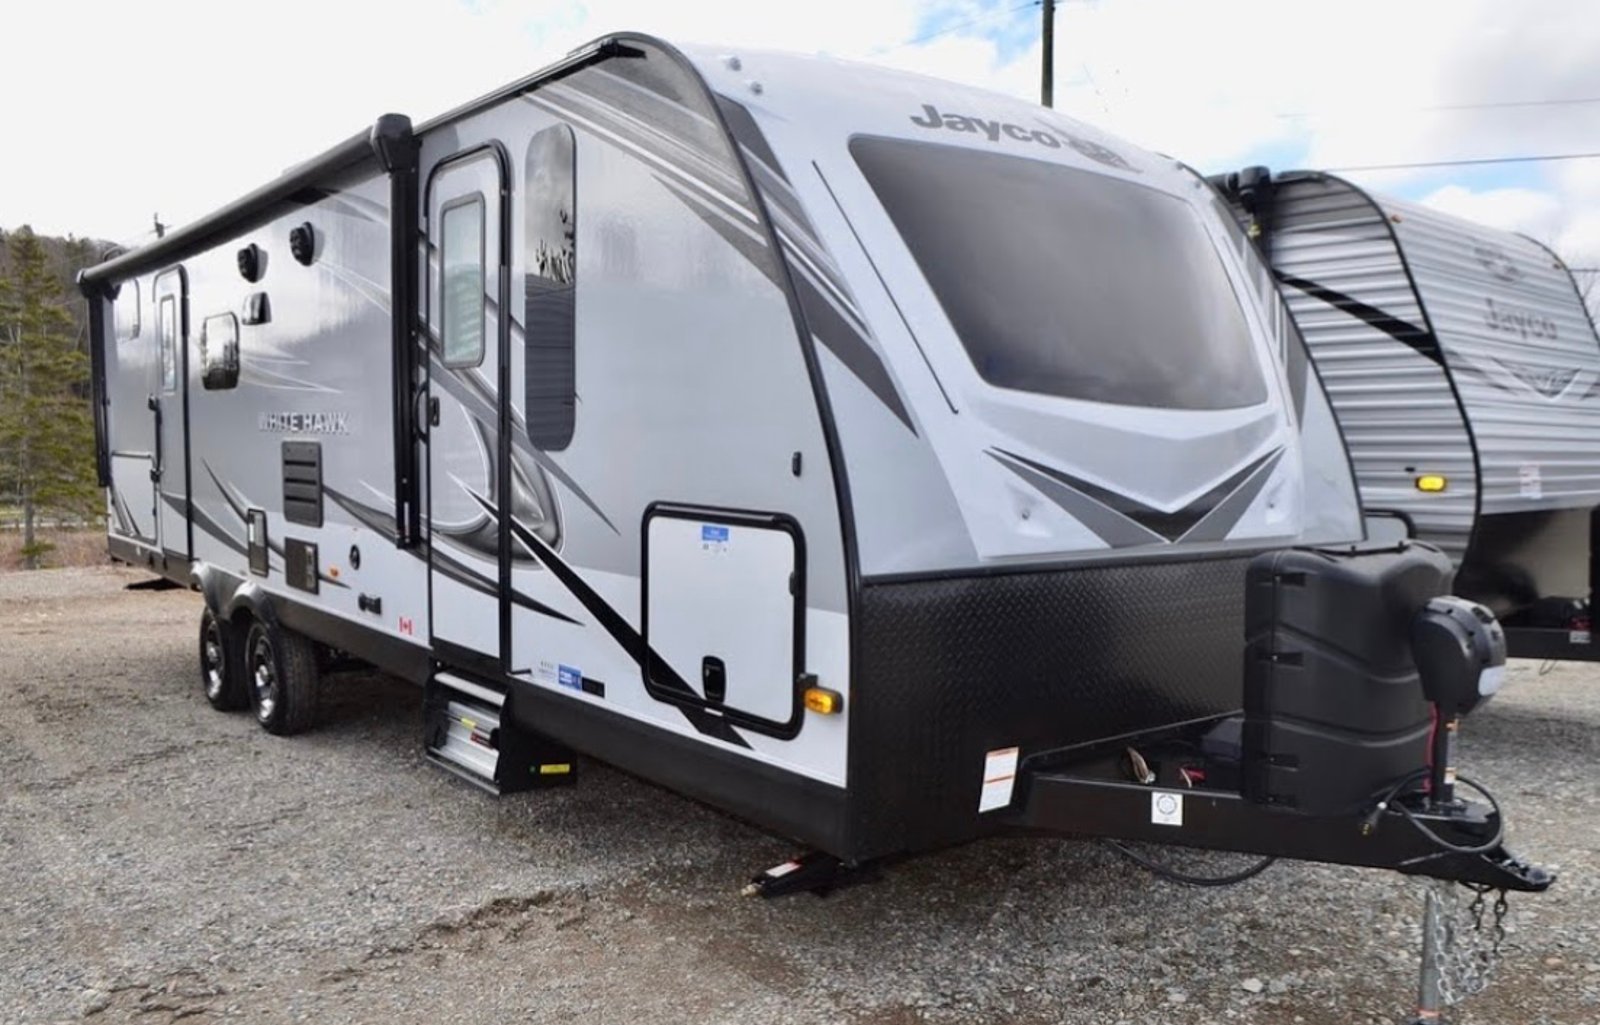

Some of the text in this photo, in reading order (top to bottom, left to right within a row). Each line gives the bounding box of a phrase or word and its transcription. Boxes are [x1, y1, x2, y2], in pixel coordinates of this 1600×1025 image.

[909, 104, 1063, 149] Jayco
[1485, 297, 1558, 340] Jayco
[258, 412, 349, 435] WHITE HAWK
